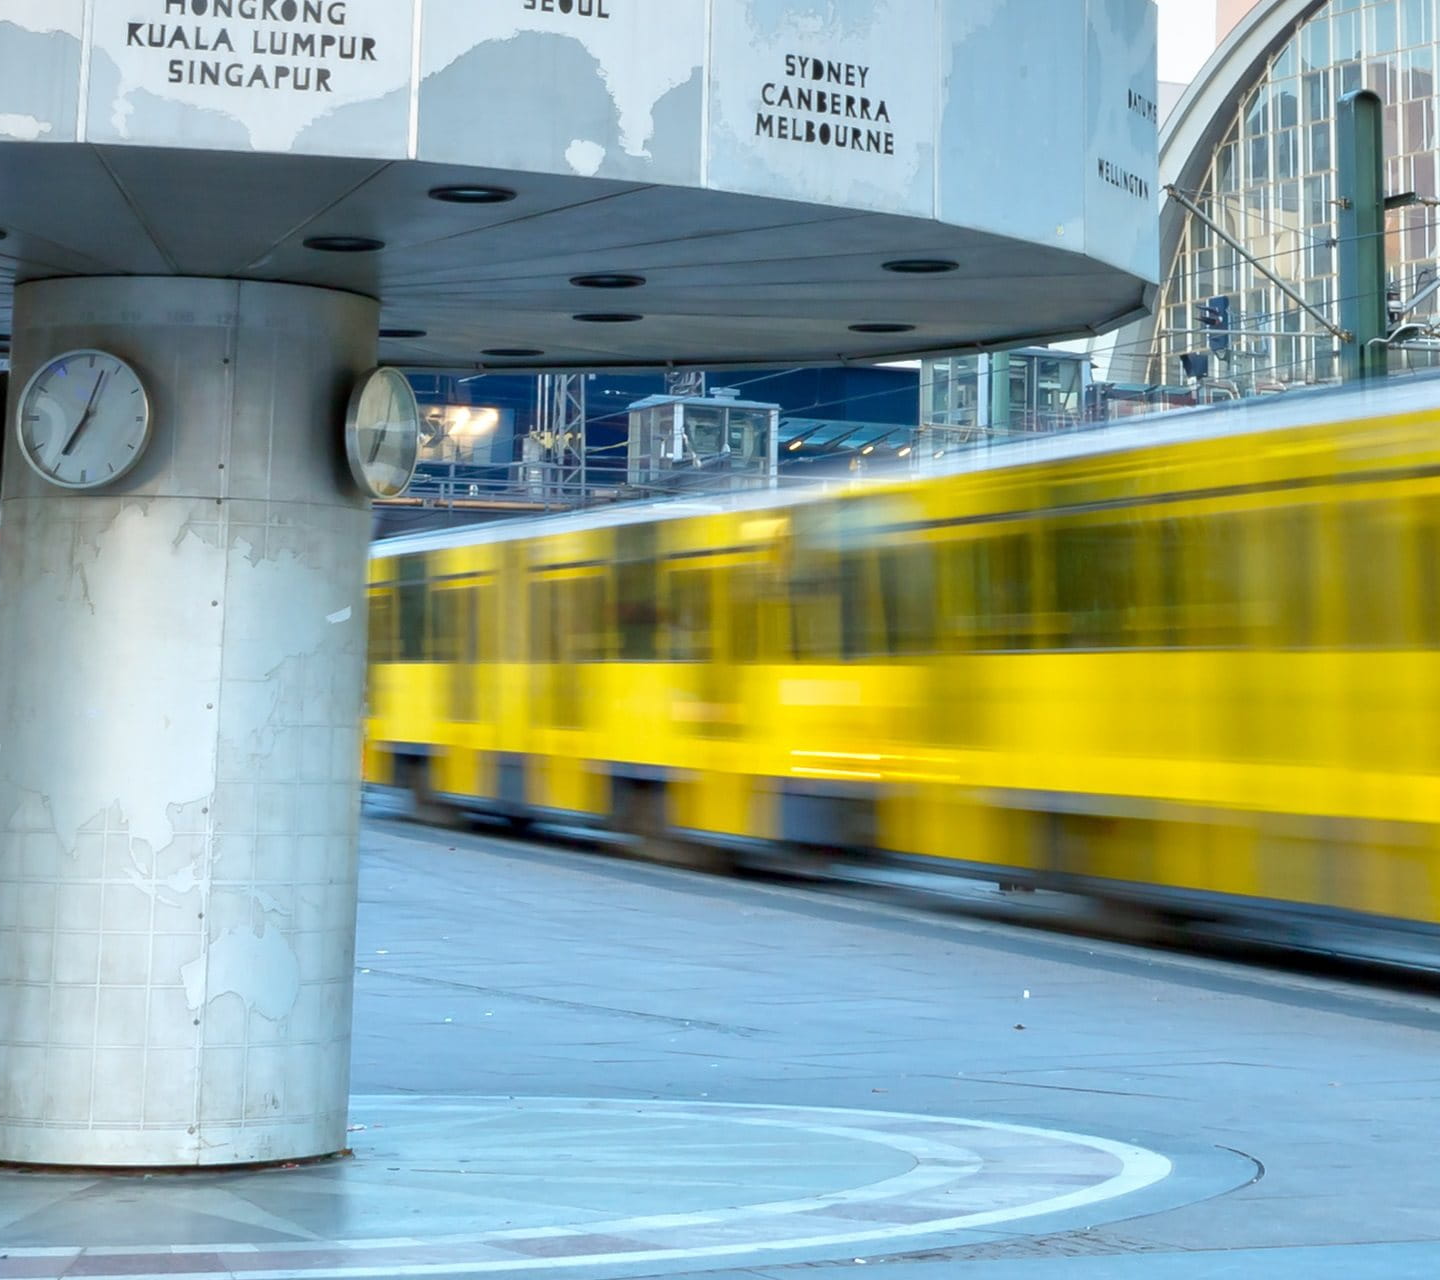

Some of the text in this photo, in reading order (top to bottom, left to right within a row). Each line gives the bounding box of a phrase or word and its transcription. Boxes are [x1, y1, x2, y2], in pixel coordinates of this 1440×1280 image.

[126, 22, 378, 61] KUALA LUMPUR
[168, 60, 332, 93] SINGAPUR
[784, 53, 870, 89] SYDNEY
[760, 82, 891, 124] CANBERRA
[754, 112, 895, 156] MELBOURNE
[1097, 157, 1150, 200] WELLINGTON
